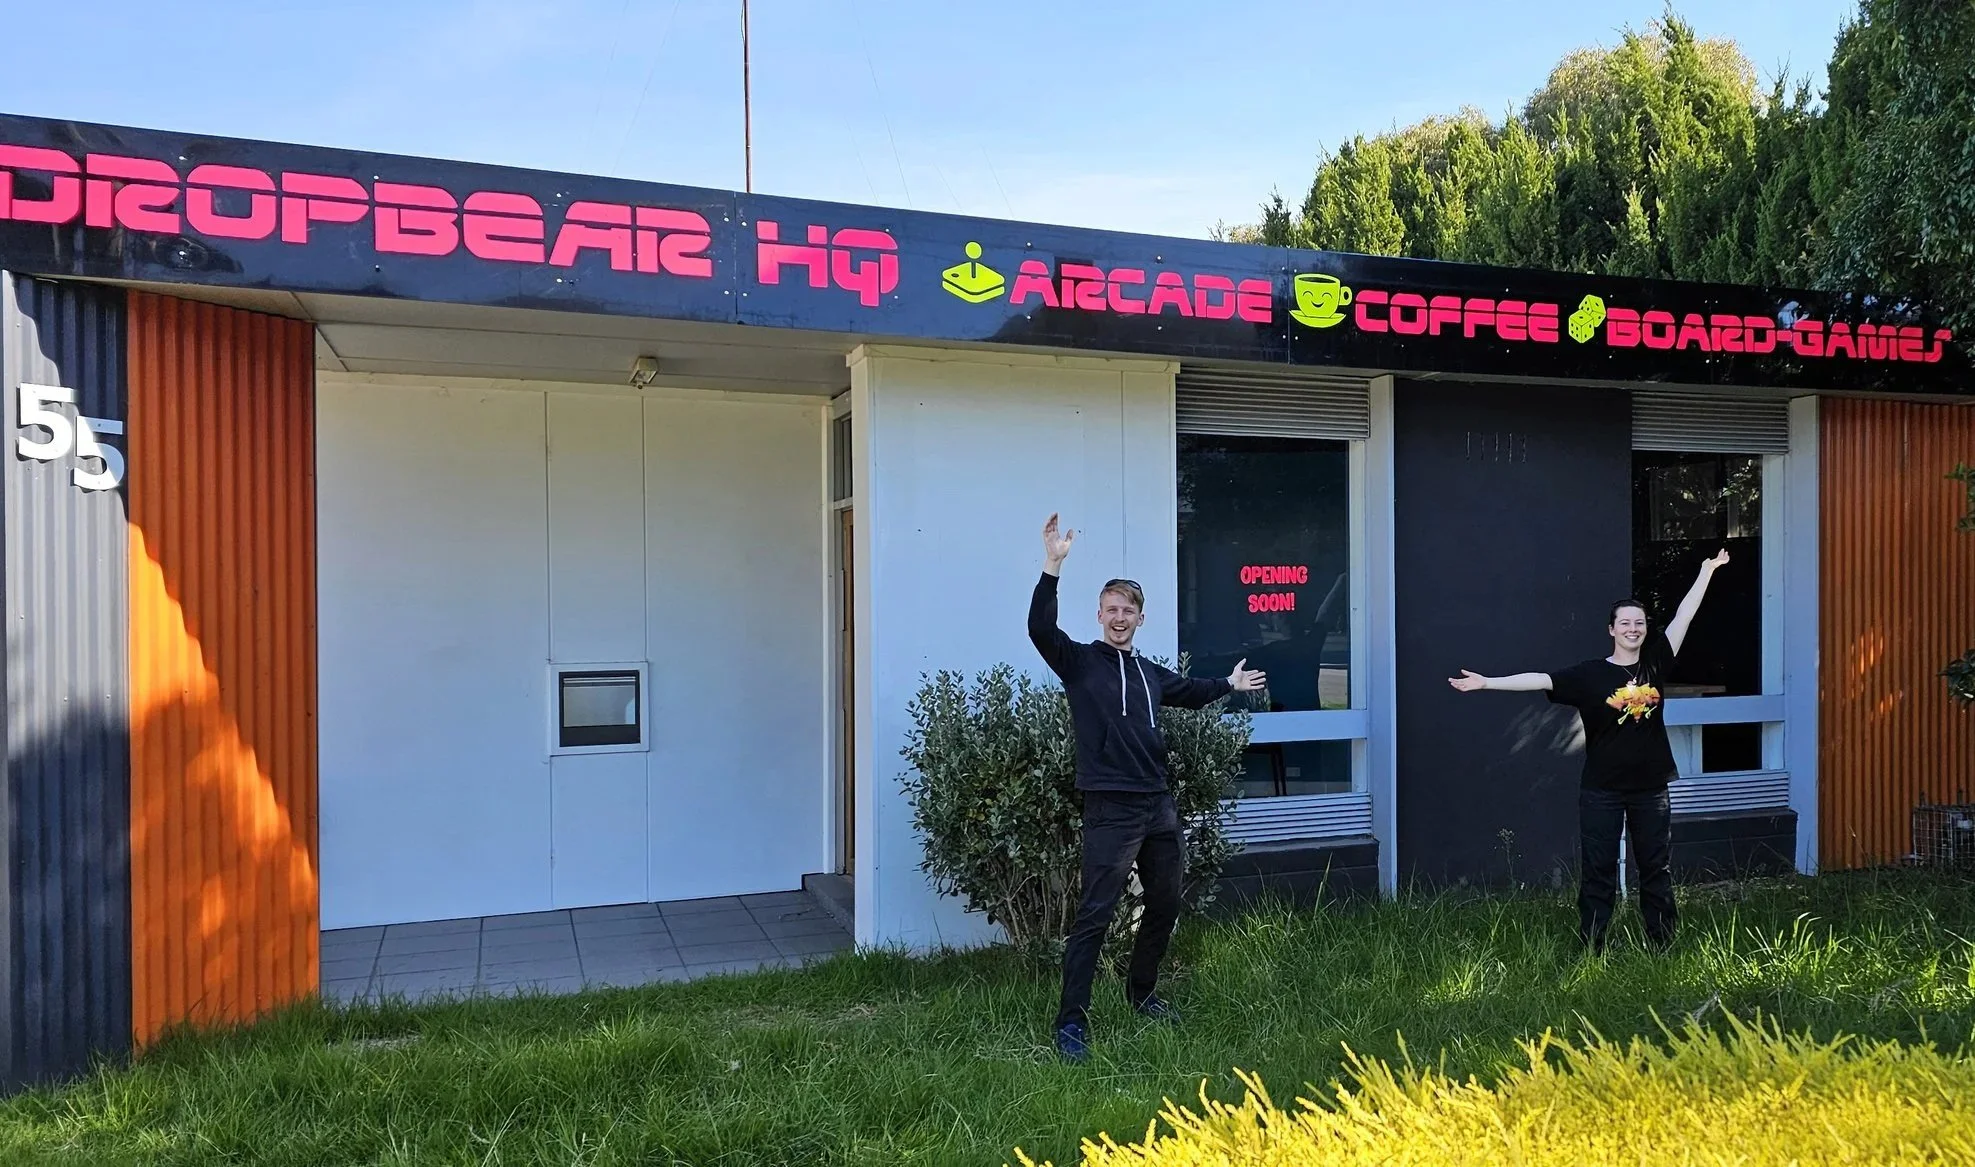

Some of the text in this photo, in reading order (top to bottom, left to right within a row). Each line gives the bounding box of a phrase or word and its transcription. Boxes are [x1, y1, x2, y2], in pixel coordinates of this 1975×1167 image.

[0, 143, 900, 308] DROPBEAR HQ
[1009, 260, 1953, 363] ARCADE COFFEE BOARD-GAMES
[18, 382, 125, 491] 55
[1240, 565, 1309, 585] OPENING
[1247, 592, 1296, 613] SOON!
